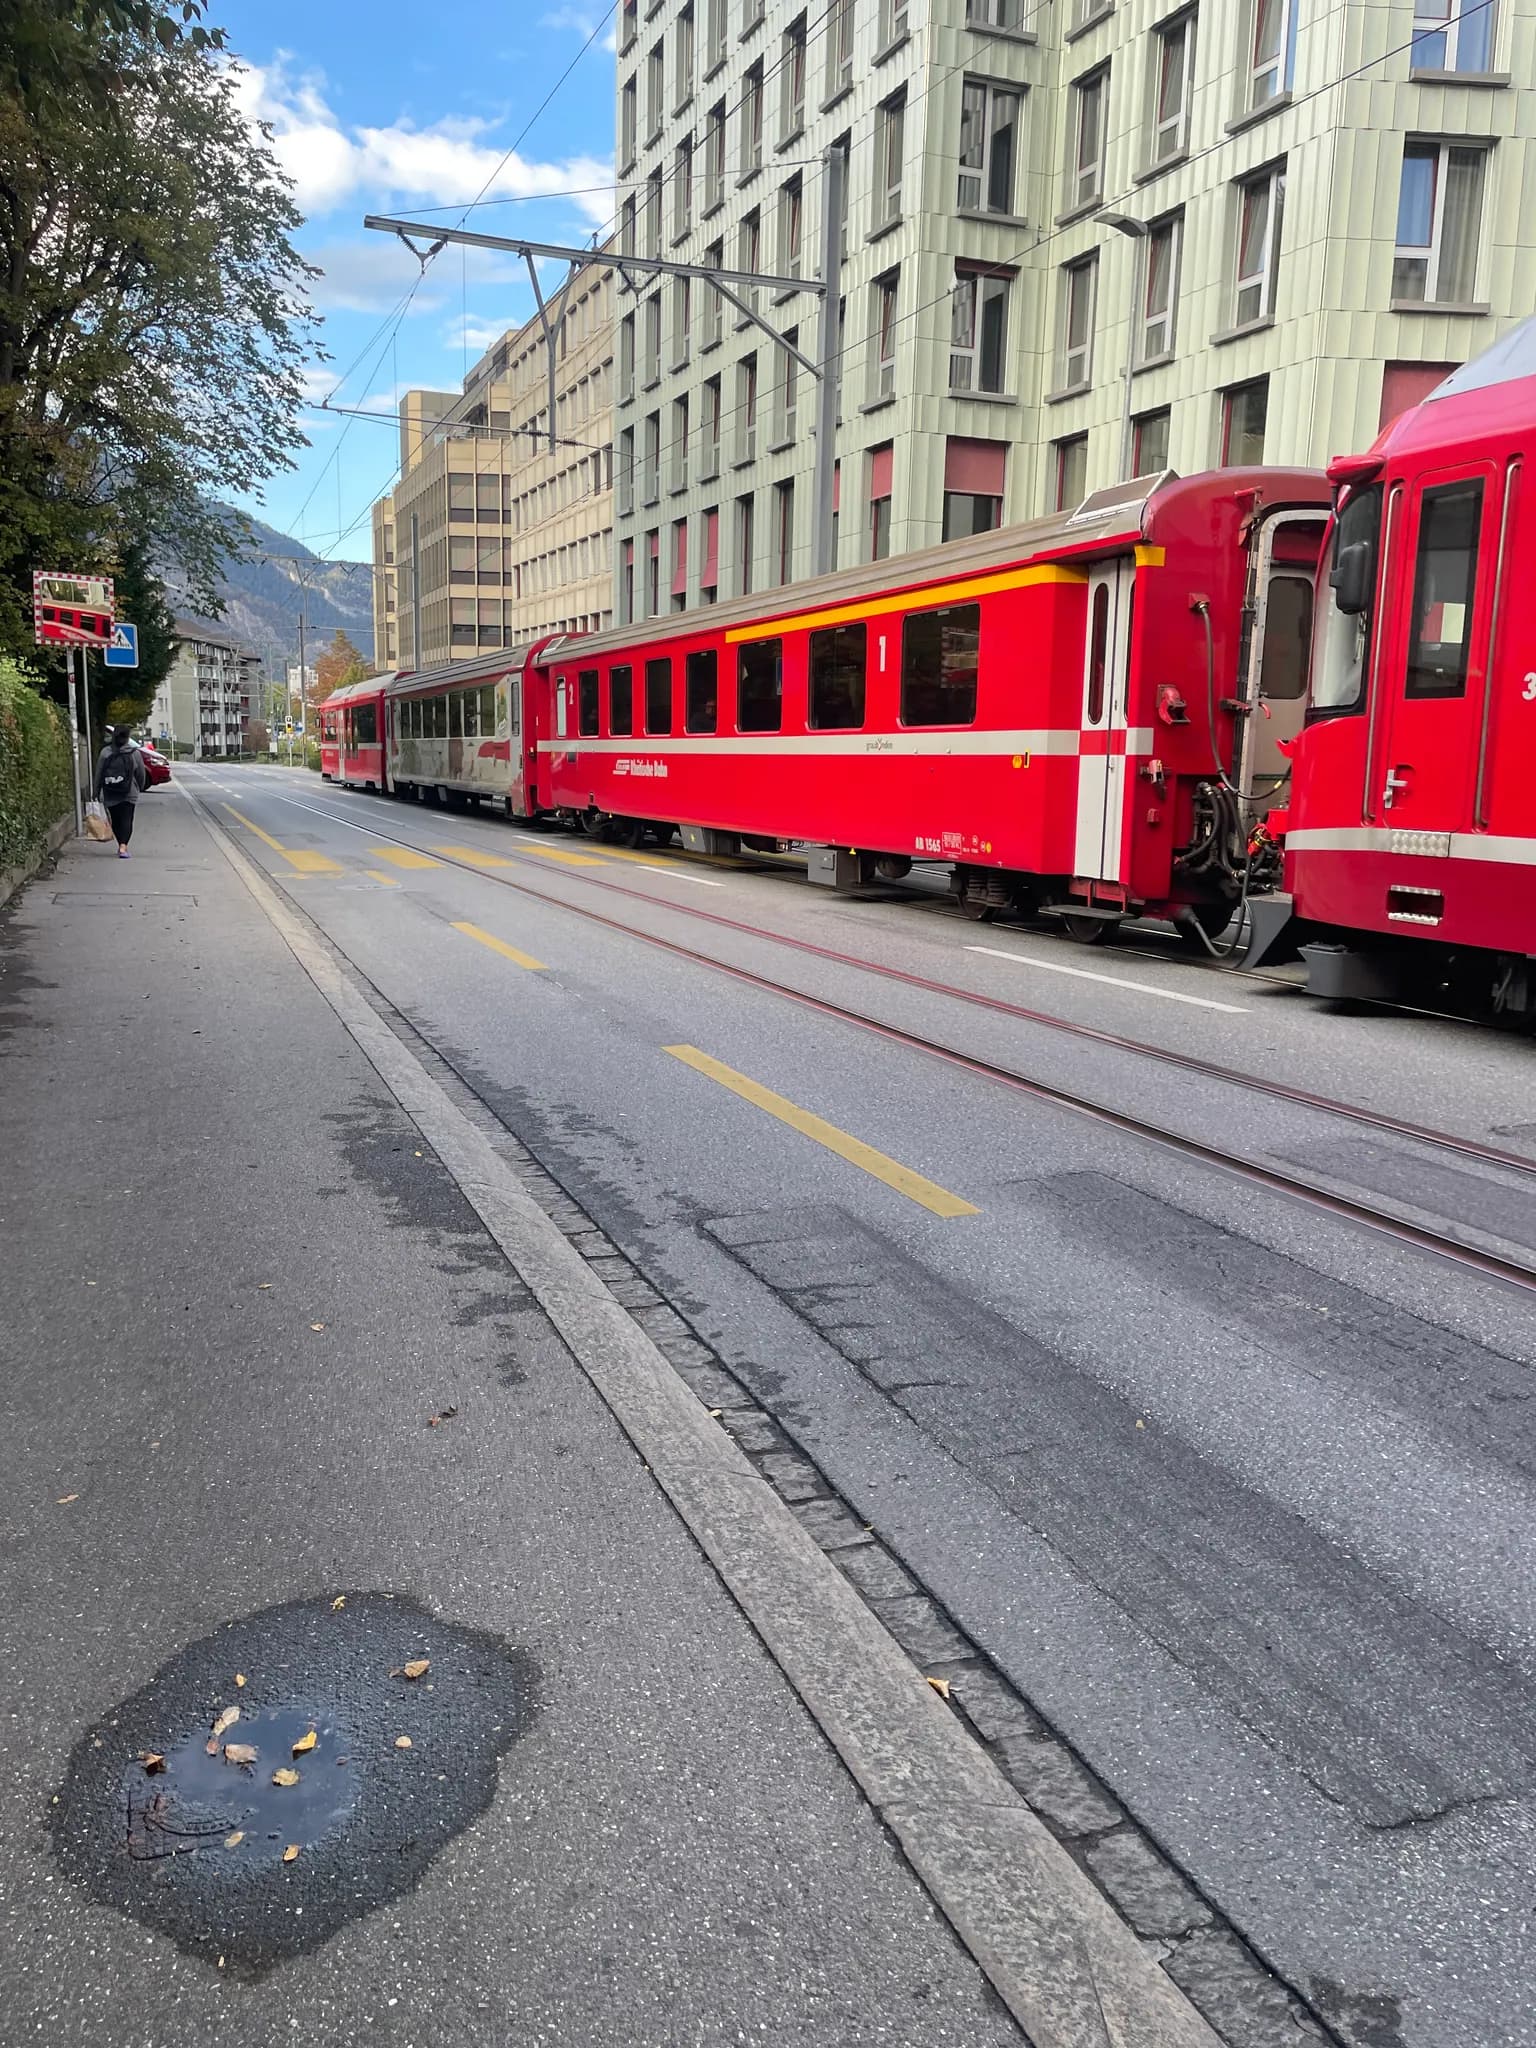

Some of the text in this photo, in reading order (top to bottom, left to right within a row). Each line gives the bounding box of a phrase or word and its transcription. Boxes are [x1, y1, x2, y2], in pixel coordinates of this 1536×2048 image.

[879, 635, 886, 672] 1
[568, 683, 574, 705] 2
[1522, 671, 1536, 701] 3
[925, 838, 941, 853] 1565
